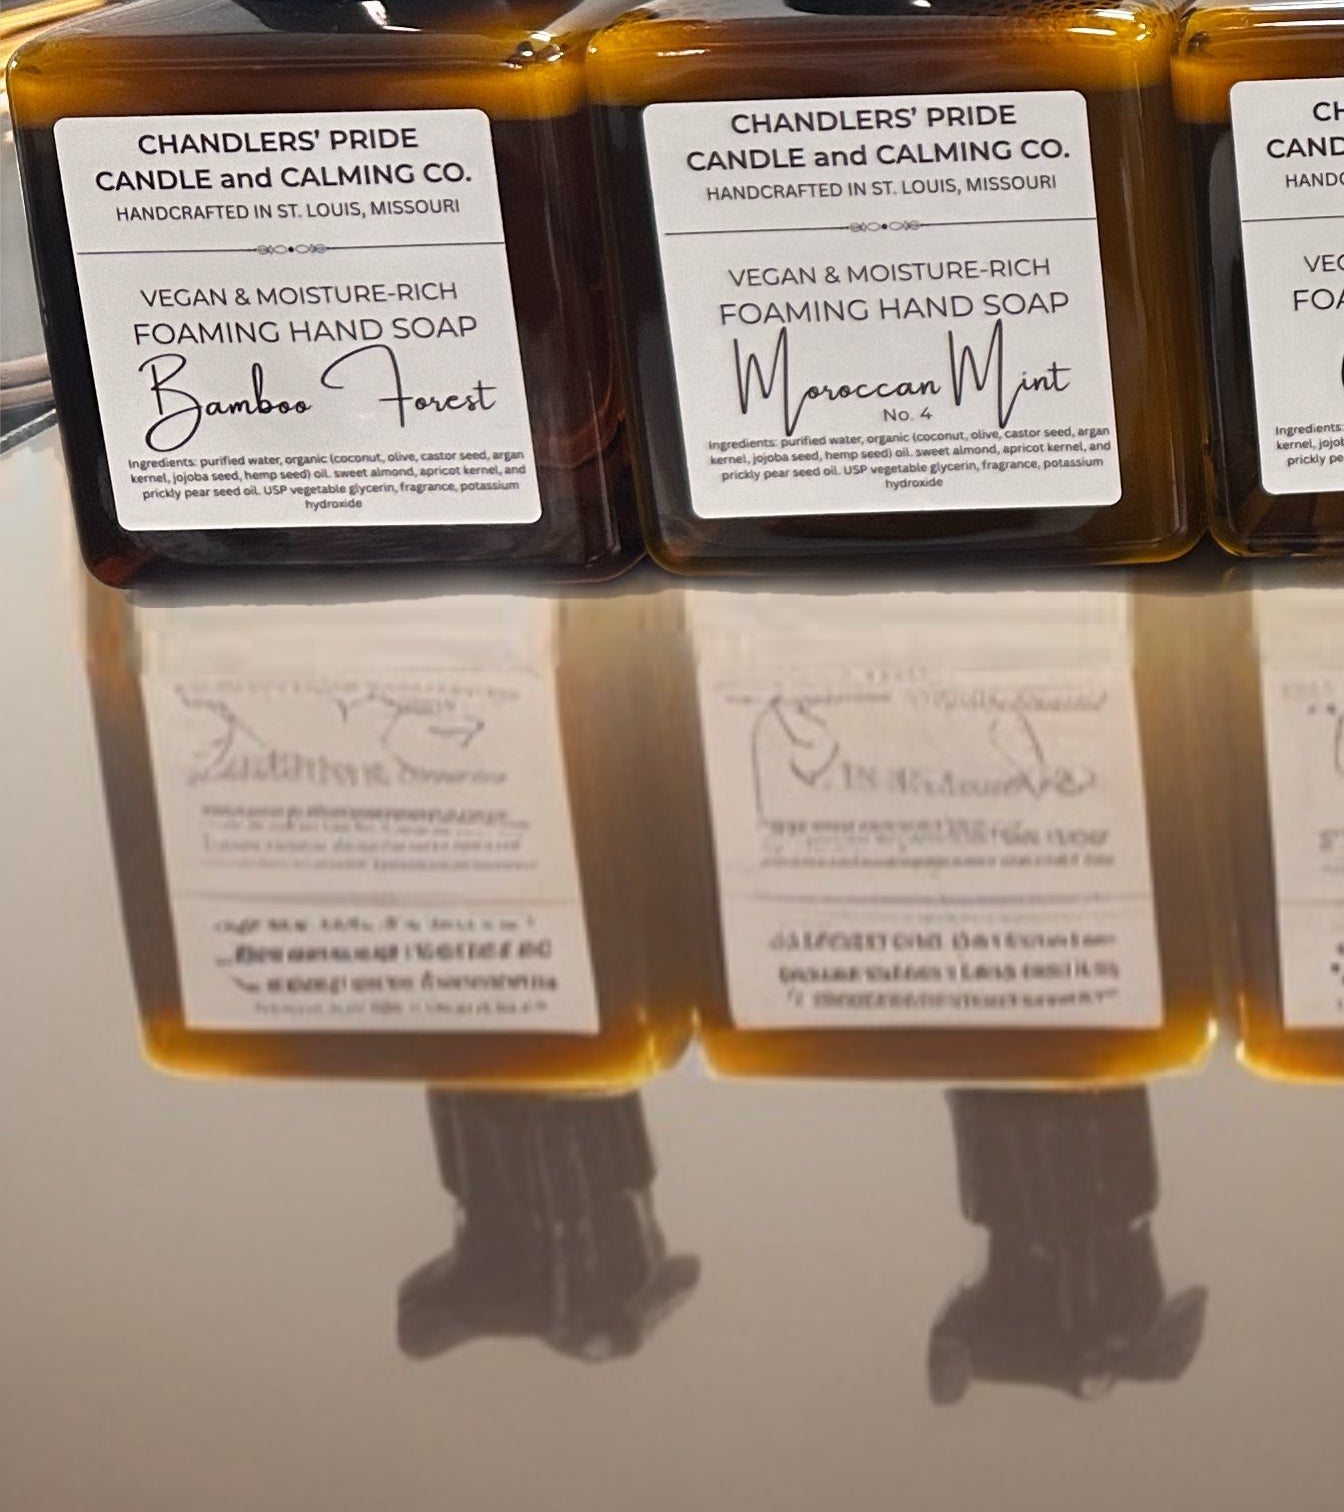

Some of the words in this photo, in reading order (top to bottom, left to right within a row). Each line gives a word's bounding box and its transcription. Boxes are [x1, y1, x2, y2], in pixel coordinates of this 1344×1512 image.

[730, 106, 918, 135] CHANDLERS'
[925, 103, 1018, 128] PRIDE
[137, 128, 321, 156] CHANDLERS'
[328, 127, 420, 151] PRIDE
[685, 147, 807, 172] CANDLE
[813, 143, 868, 168] and
[875, 139, 1013, 166] CALMING
[1019, 137, 1071, 160] CO.
[94, 168, 214, 192] CANDLE
[219, 165, 273, 190] and
[280, 162, 416, 188] CALMING
[422, 161, 473, 184] CO.
[115, 204, 250, 223] HANDCRAFTED
[253, 203, 273, 220] IN
[276, 202, 303, 220] ST.
[305, 201, 367, 220] LOUIS,
[369, 198, 461, 216] MISSOURI
[727, 266, 817, 289] VEGAN
[823, 265, 842, 285] &
[846, 257, 1051, 284] MOISTURE-RICH
[139, 287, 228, 309] VEGAN
[234, 287, 252, 307] &
[255, 281, 458, 306] MOISTURE-RICH
[717, 298, 869, 326] FOAMING
[878, 294, 974, 321] HAND
[981, 291, 1070, 317] SOAP
[133, 320, 281, 347] FOAMING
[288, 318, 384, 343] HAND
[390, 315, 478, 340] SOAP
[732, 325, 942, 438] Moroccan
[947, 317, 1072, 432] Mint
[137, 352, 313, 454] Bamboo
[319, 343, 498, 429] Forest
[881, 407, 914, 423] No.
[919, 406, 934, 421] 4
[304, 497, 364, 513] hydroxide
